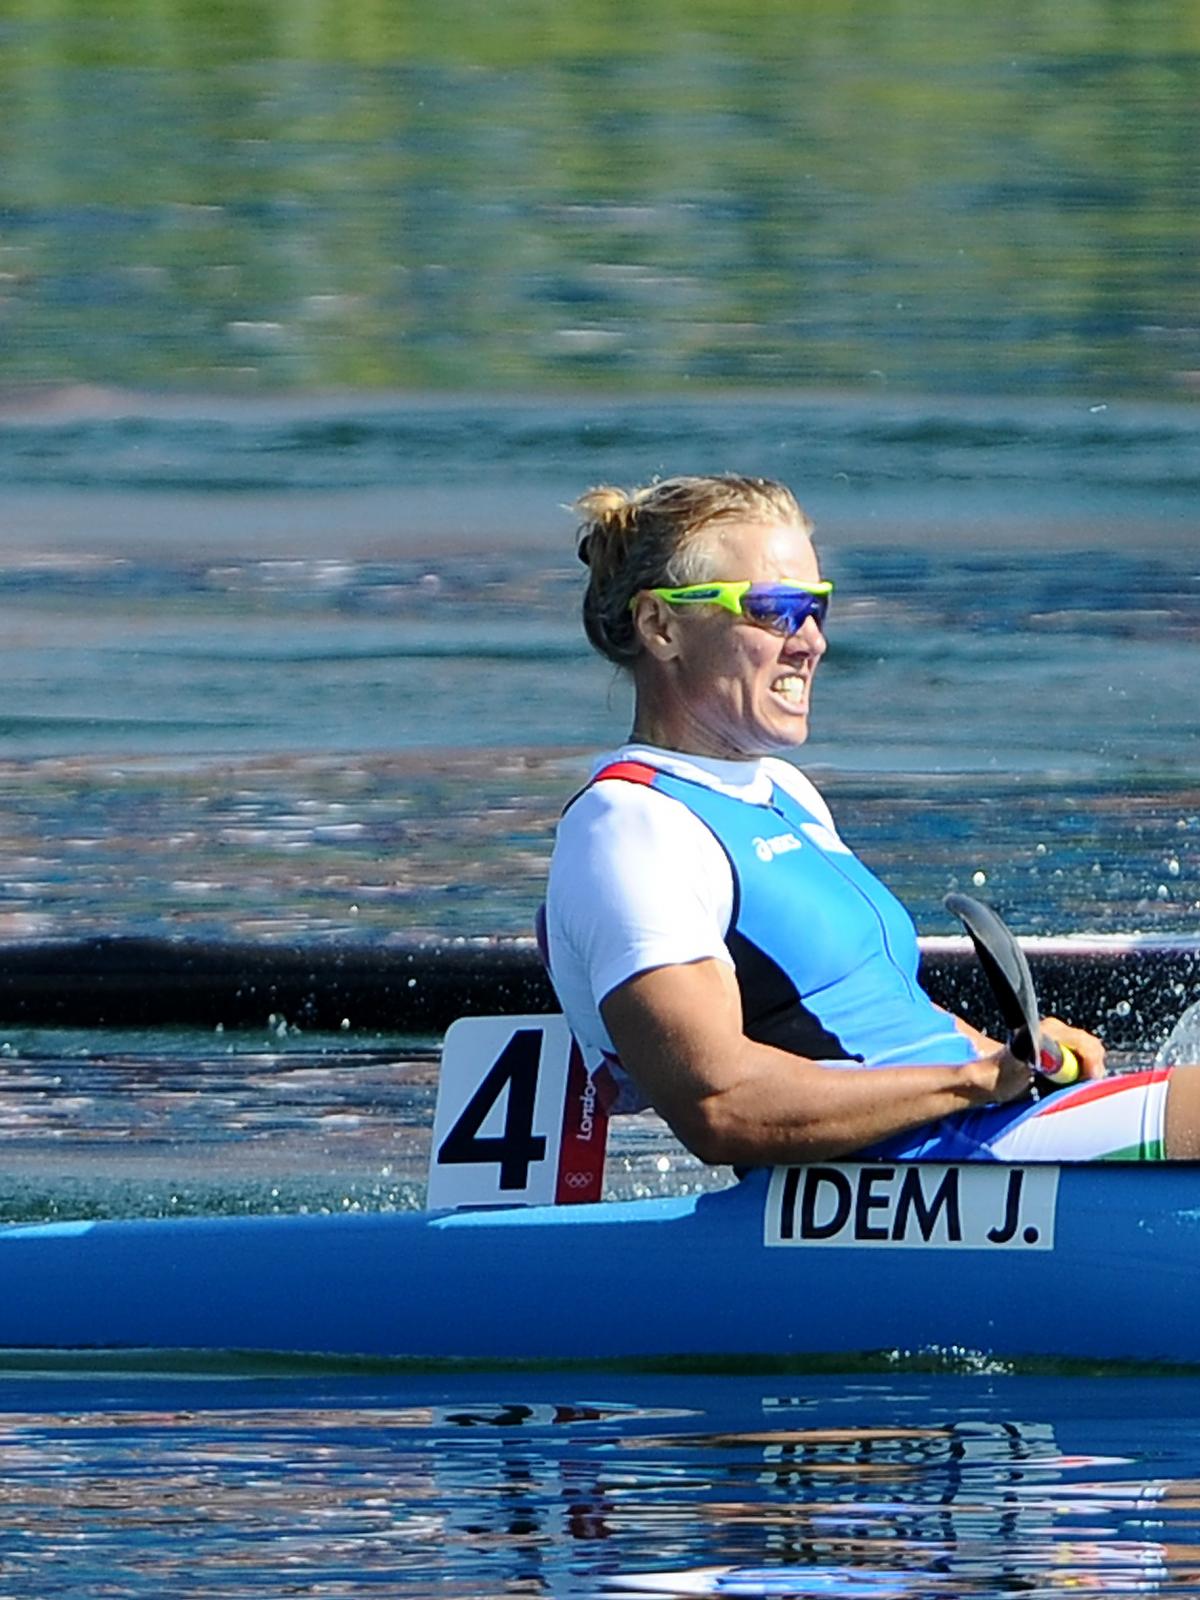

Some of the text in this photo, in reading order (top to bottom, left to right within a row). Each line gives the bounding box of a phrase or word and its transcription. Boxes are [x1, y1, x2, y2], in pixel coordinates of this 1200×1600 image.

[437, 1028, 547, 1190] 4
[576, 1073, 597, 1141] Londo
[779, 1167, 1040, 1244] IDEM J.
